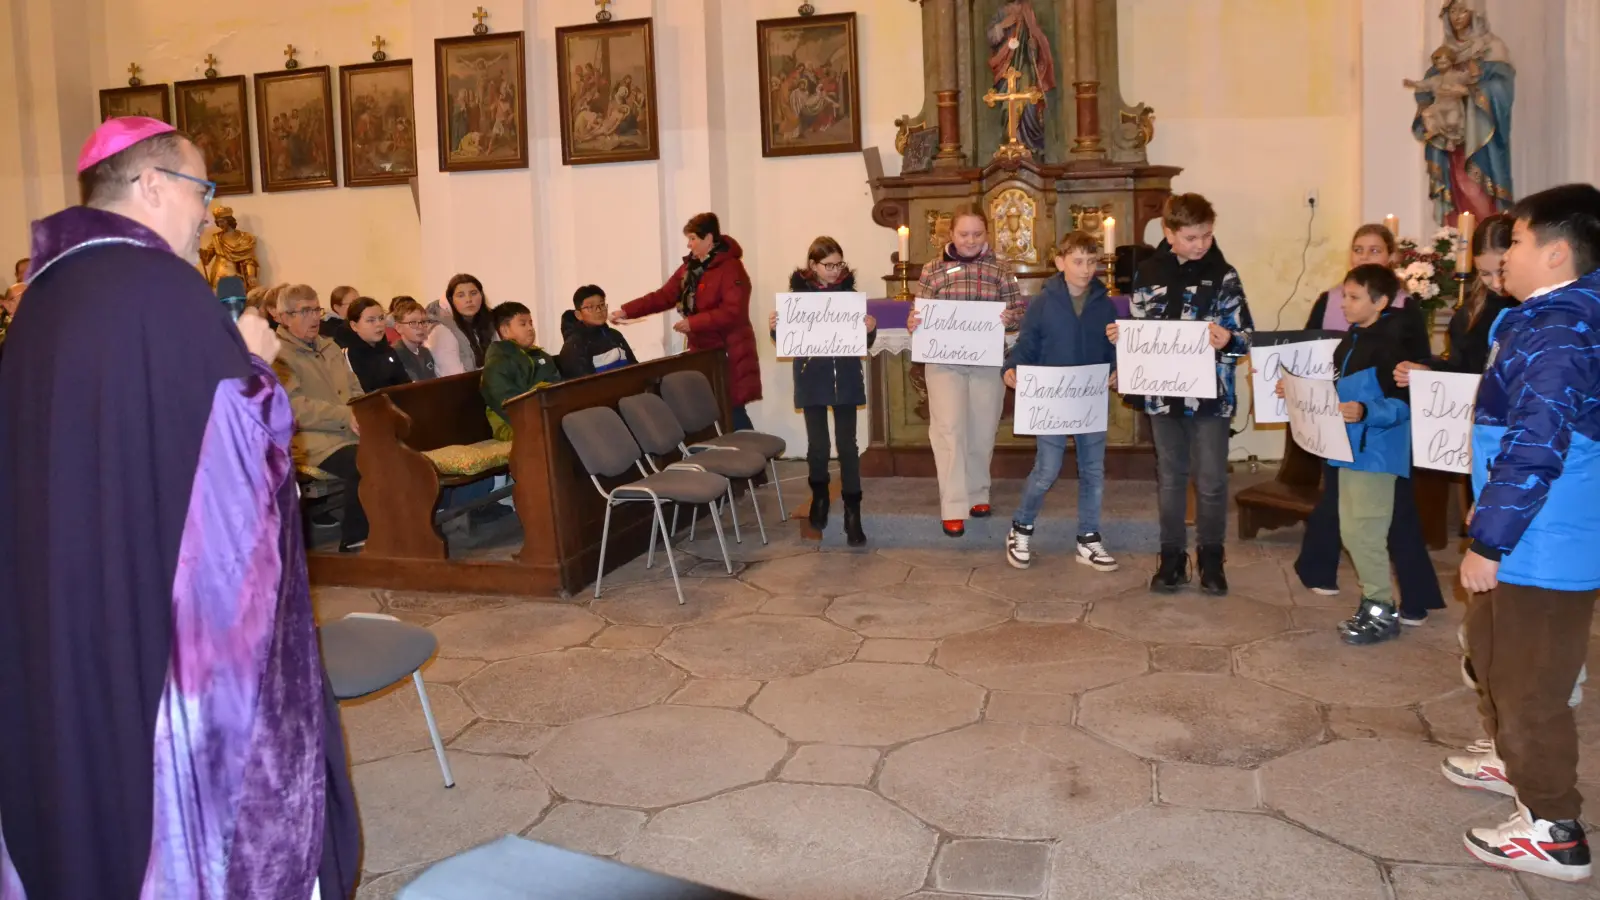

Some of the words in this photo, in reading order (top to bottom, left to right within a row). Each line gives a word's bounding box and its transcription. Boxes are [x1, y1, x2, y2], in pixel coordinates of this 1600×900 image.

[784, 297, 866, 332] Vergebung
[1124, 323, 1210, 355] Wahrheit
[1020, 372, 1108, 399] Dankbarkeit
[1130, 364, 1198, 392] Pravda
[1029, 404, 1099, 430] Vděčnost
